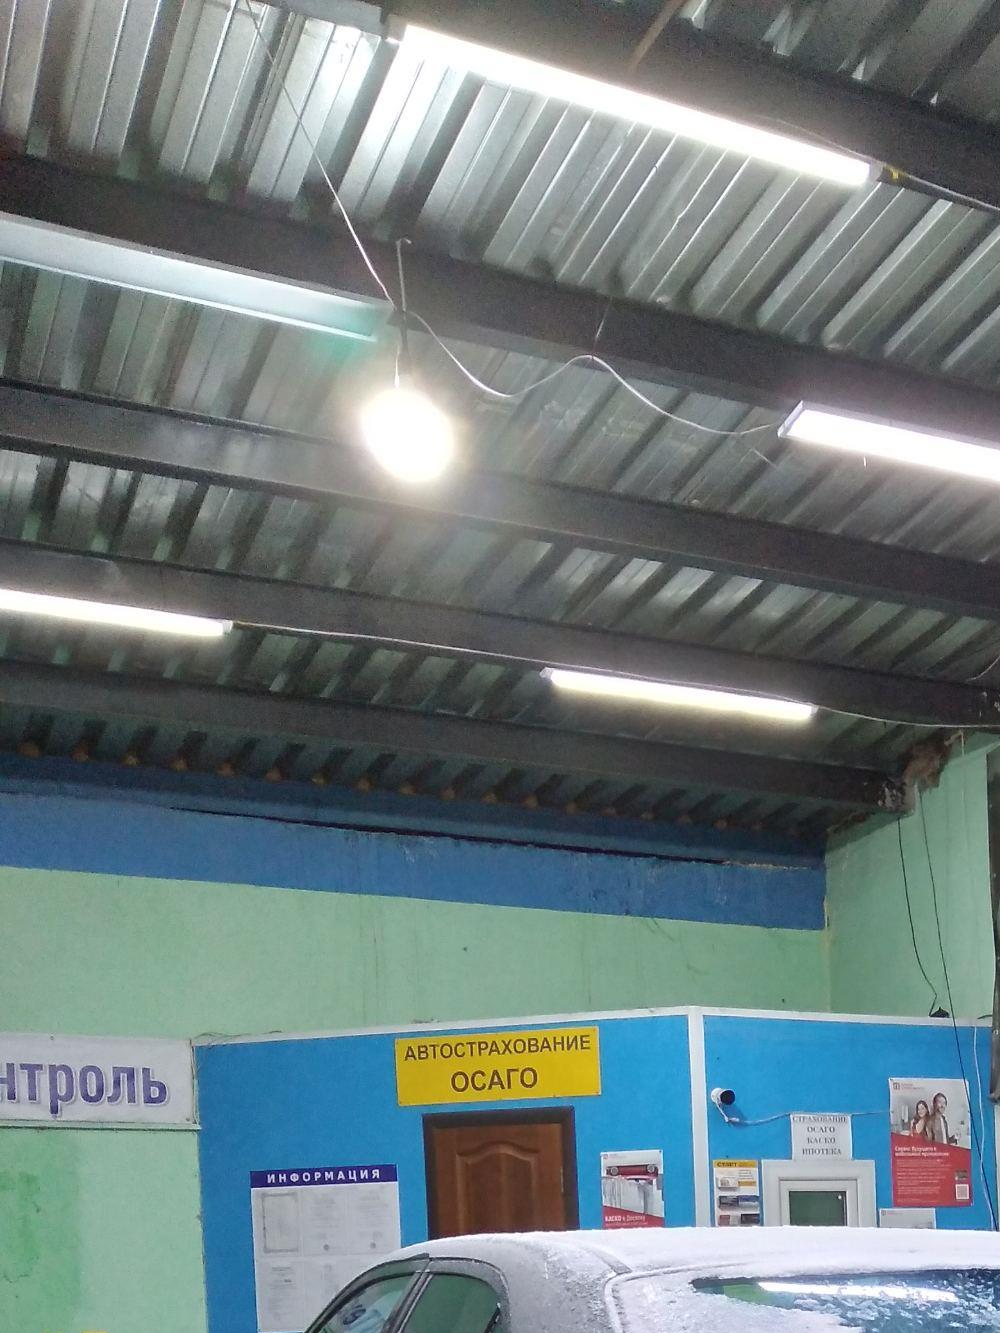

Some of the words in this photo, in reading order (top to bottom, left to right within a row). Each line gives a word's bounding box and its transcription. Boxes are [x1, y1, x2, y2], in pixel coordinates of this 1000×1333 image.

[404, 1035, 591, 1061] АВТОСТРАХОВАНИЕ
[451, 1067, 538, 1092] ОСАГО
[267, 1169, 380, 1184] ИНФОРМАЦИЯ
